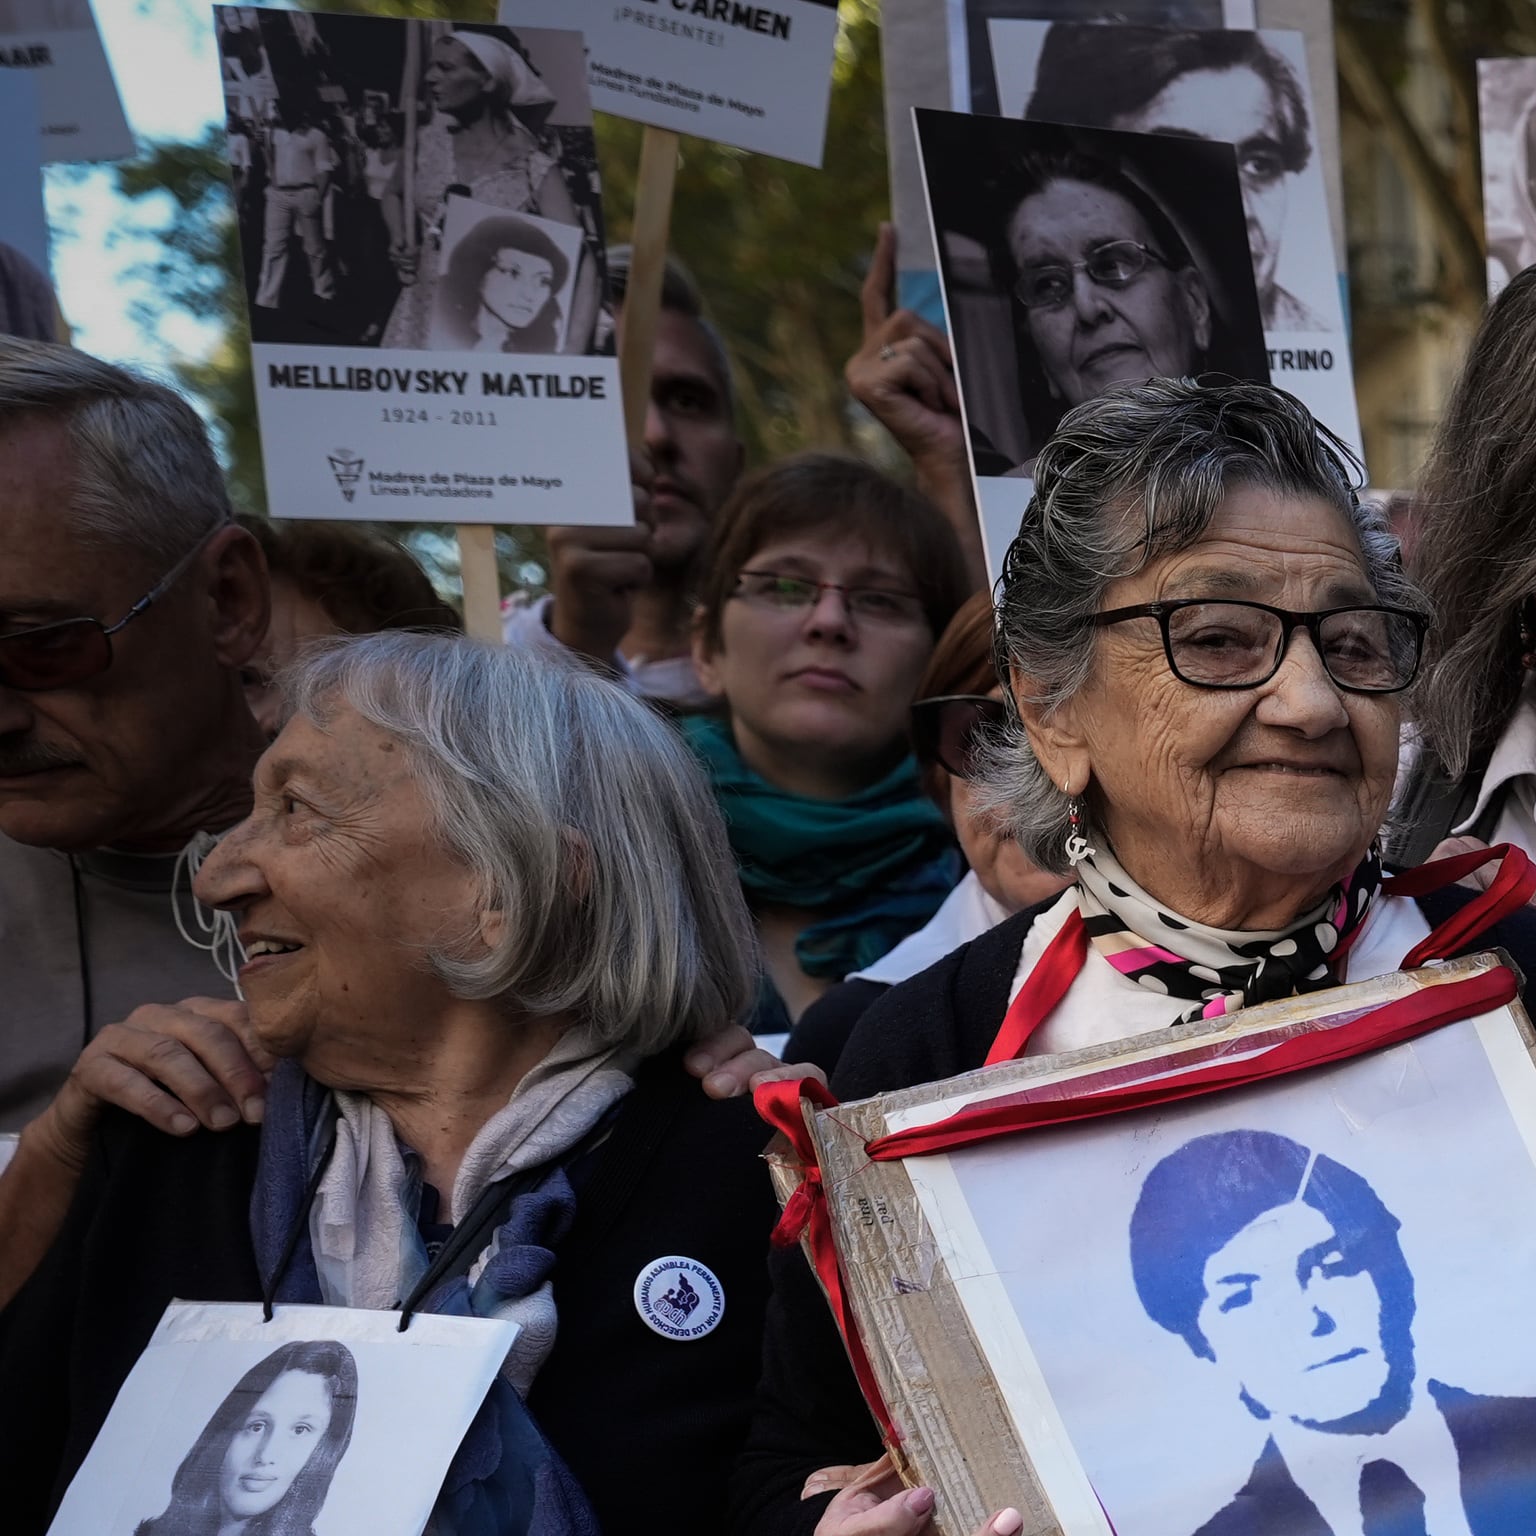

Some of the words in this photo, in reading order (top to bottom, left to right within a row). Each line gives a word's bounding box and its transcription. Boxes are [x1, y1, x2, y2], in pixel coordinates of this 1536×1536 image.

[268, 364, 467, 394] MELLIBOVSKY
[482, 373, 606, 399] MATILDE
[381, 408, 428, 423] 1924
[450, 410, 497, 426] 2011
[369, 471, 425, 485] Madres
[430, 473, 449, 485] de
[454, 473, 494, 486] Plaza
[499, 474, 517, 487] de
[522, 476, 563, 488] Mayo
[413, 486, 493, 499] Fundadora
[650, 1261, 690, 1279] ASAMBLEA
[640, 1276, 654, 1314] HUMANOS
[691, 1264, 721, 1311] PERMANENTE
[649, 1314, 690, 1337] DERECHOS
[706, 1311, 719, 1327] POR
[692, 1323, 708, 1335] LOS
